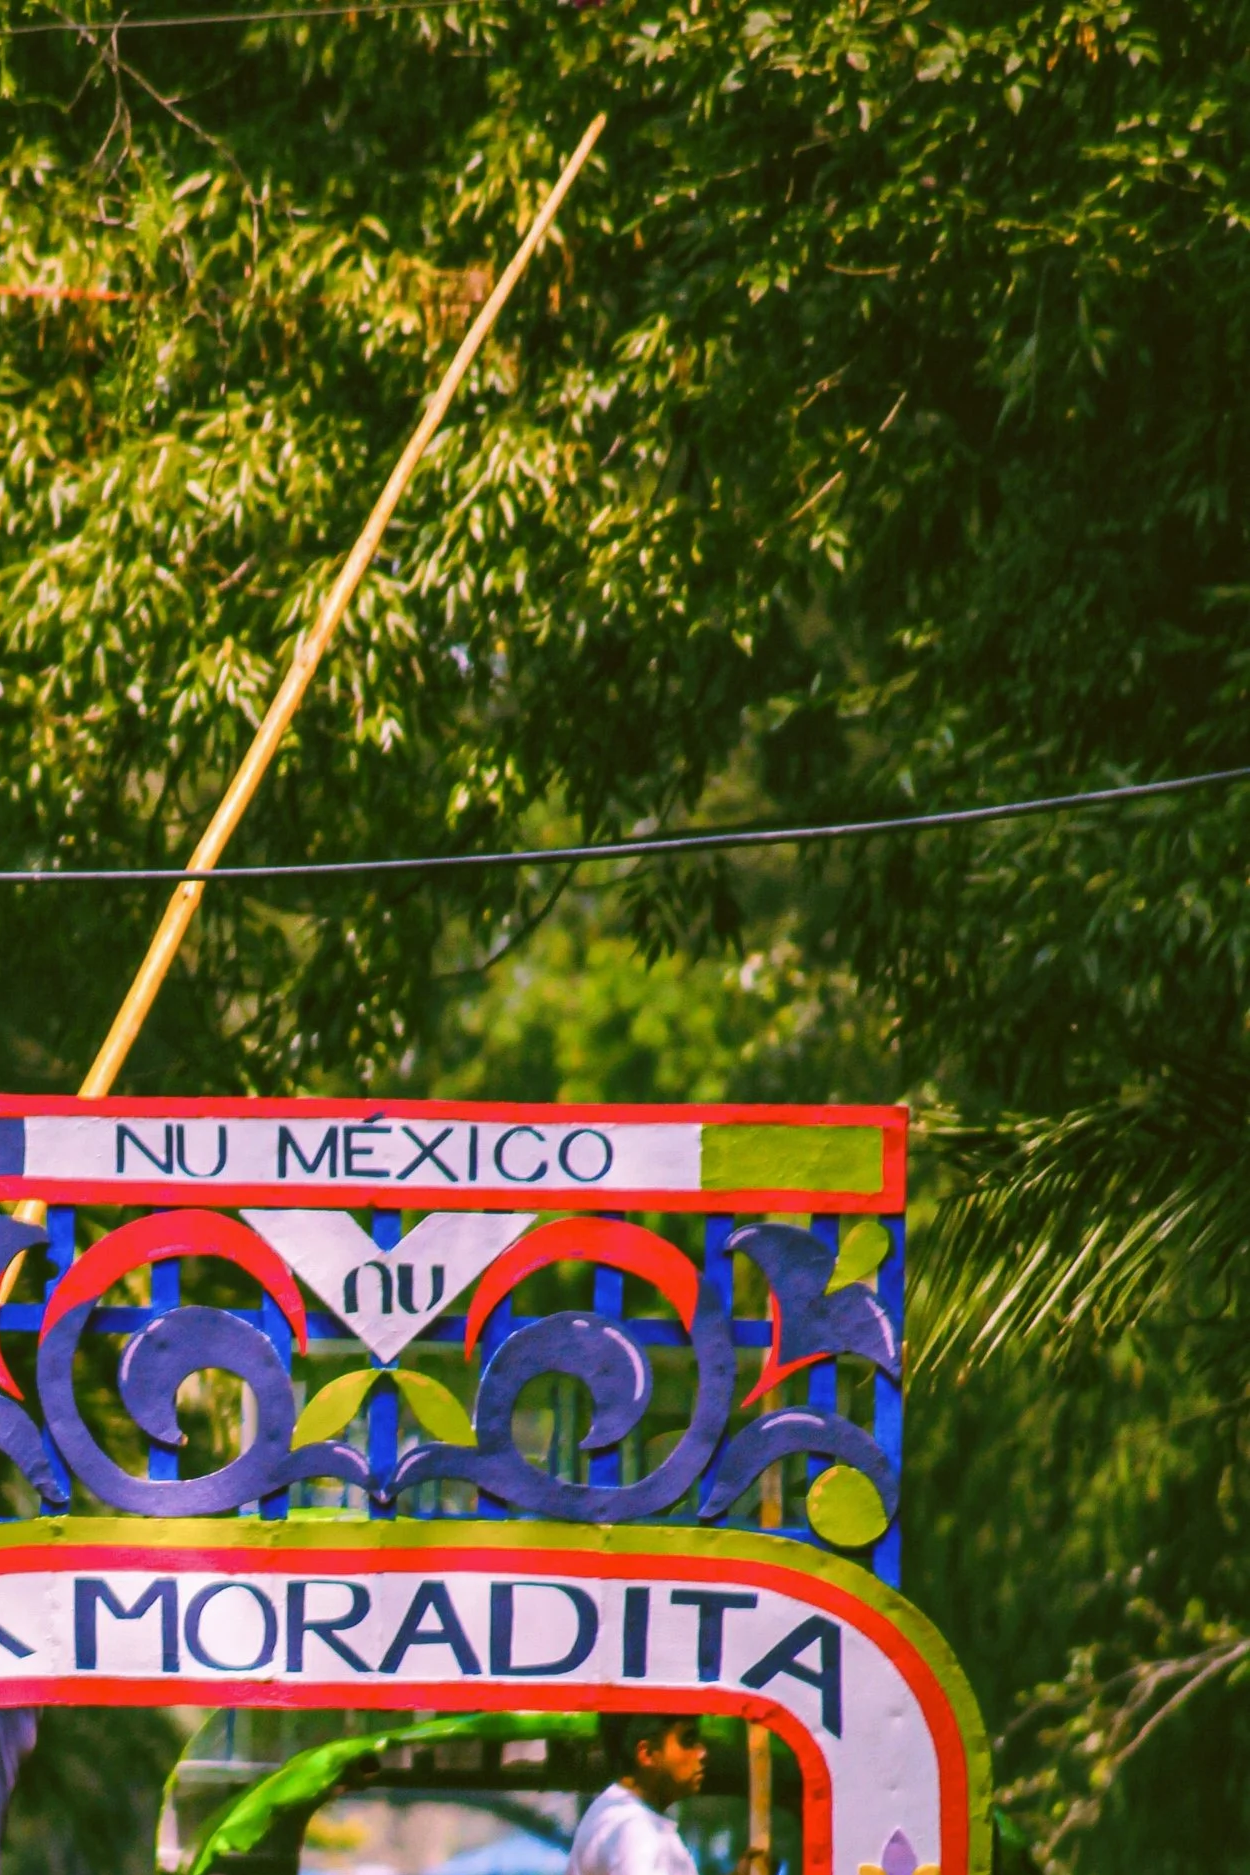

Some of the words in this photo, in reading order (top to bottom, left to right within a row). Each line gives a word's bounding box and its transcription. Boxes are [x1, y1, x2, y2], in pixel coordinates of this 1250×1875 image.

[114, 1123, 229, 1178] NU
[275, 1113, 615, 1184] MÉXICO
[72, 1576, 844, 1741] MORADITA
